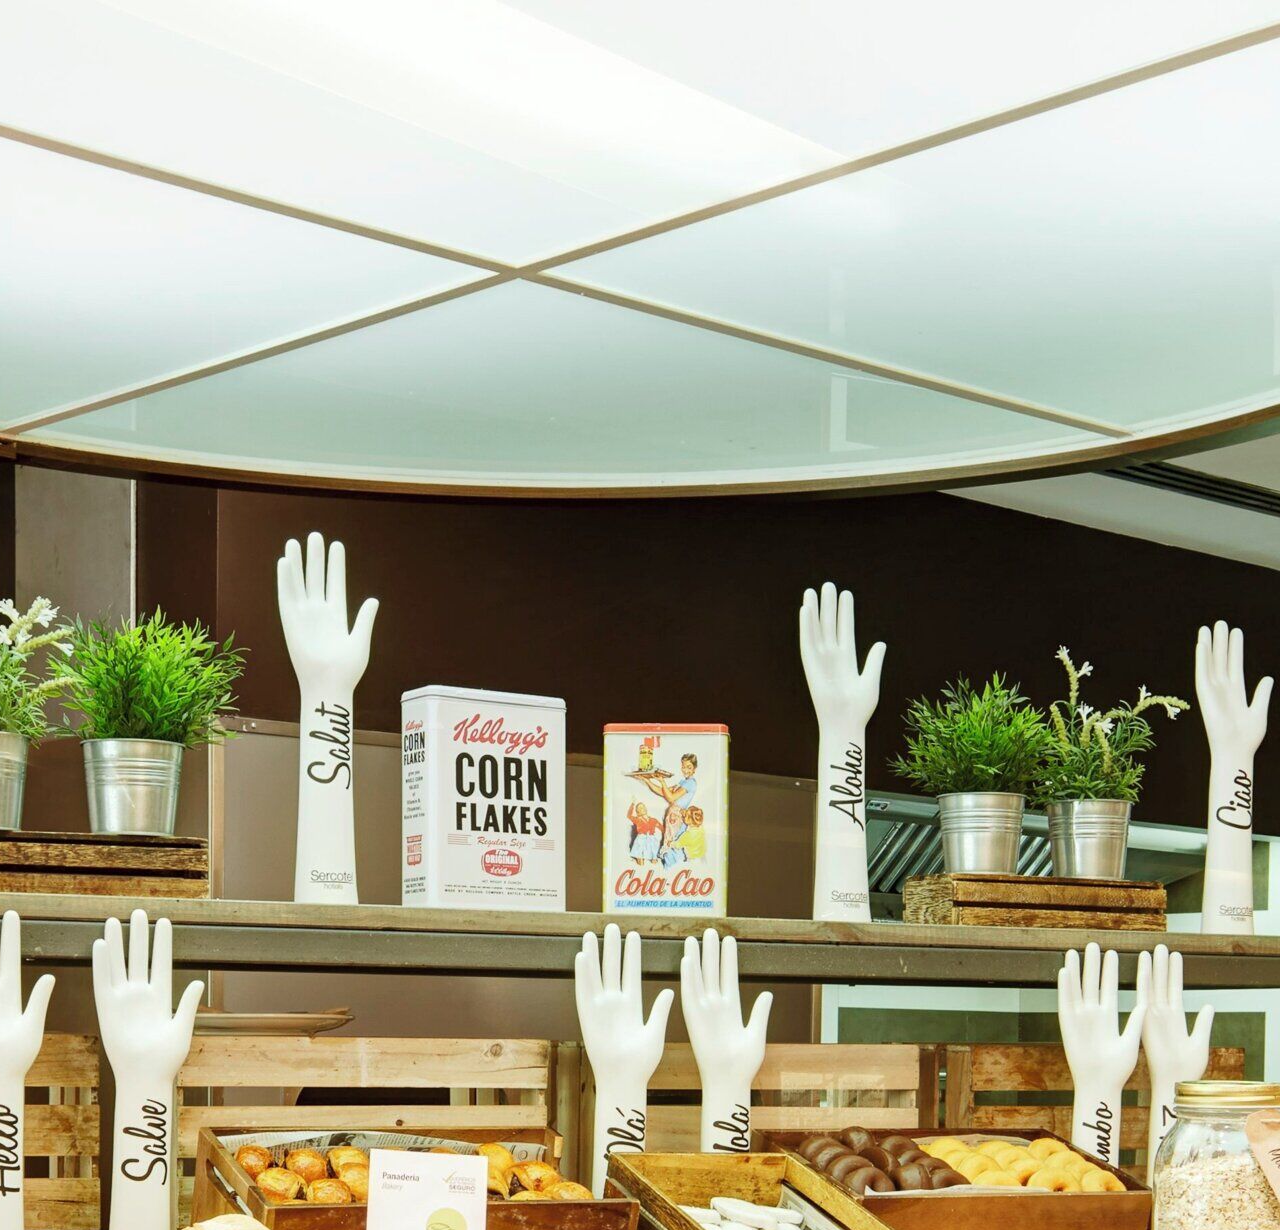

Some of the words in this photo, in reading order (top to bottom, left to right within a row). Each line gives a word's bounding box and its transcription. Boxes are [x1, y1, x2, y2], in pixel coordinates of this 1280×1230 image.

[306, 701, 351, 790] Salut
[404, 731, 425, 752] CORN
[453, 713, 549, 755] Kellogg's
[404, 751, 425, 766] FLAKES
[456, 752, 547, 802] CORN
[829, 741, 864, 831] Aloha
[1216, 769, 1252, 830] Ciao
[456, 802, 547, 837] FLAKES
[477, 836, 507, 848] Regular
[310, 869, 353, 882] Sercote
[614, 869, 715, 897] Cola-Cao
[831, 890, 868, 901] Sercote
[1219, 904, 1253, 915] Sercote
[121, 1098, 168, 1185] Salve
